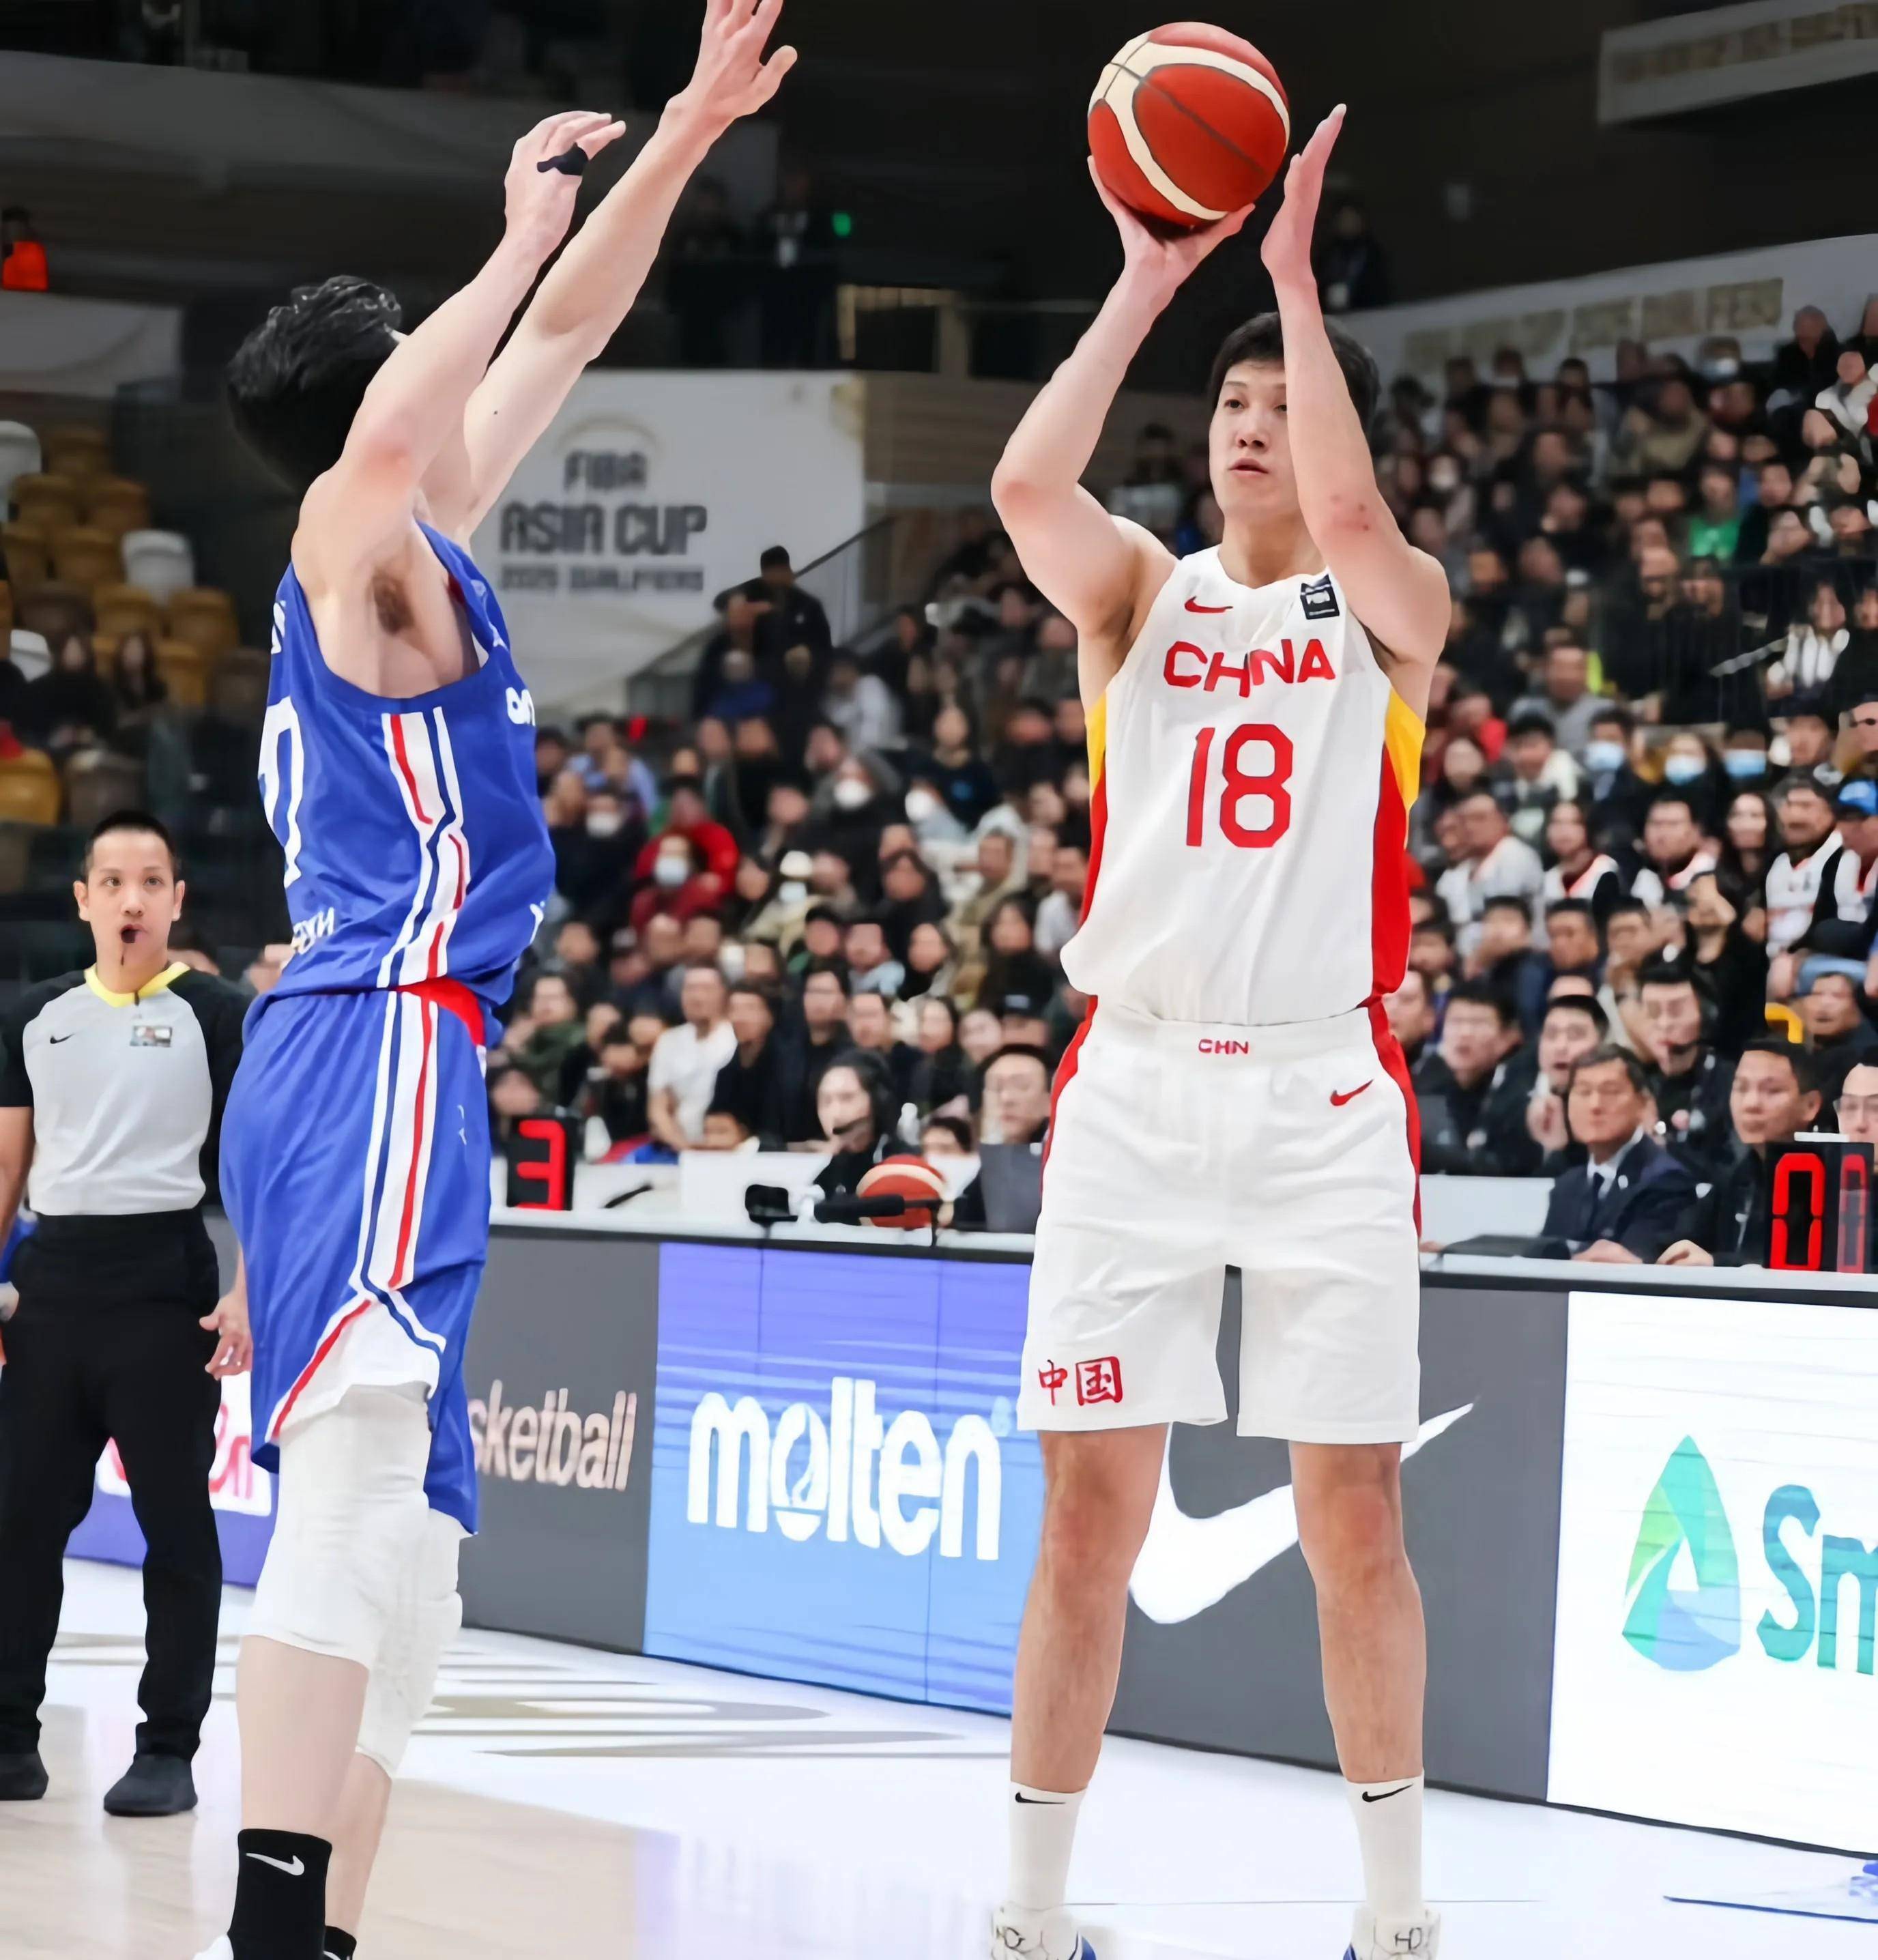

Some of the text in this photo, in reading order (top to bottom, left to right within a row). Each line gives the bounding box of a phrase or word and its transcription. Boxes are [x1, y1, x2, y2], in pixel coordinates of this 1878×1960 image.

[502, 502, 708, 556] ASIA CUP
[1163, 639, 1336, 698] CHNA
[1186, 723, 1294, 848] 18
[1198, 1038, 1249, 1055] CHN
[517, 1119, 566, 1211] 3
[1038, 1355, 1123, 1407] 中国
[687, 1376, 1002, 1561] molten
[1757, 1484, 1878, 1676] Sm
